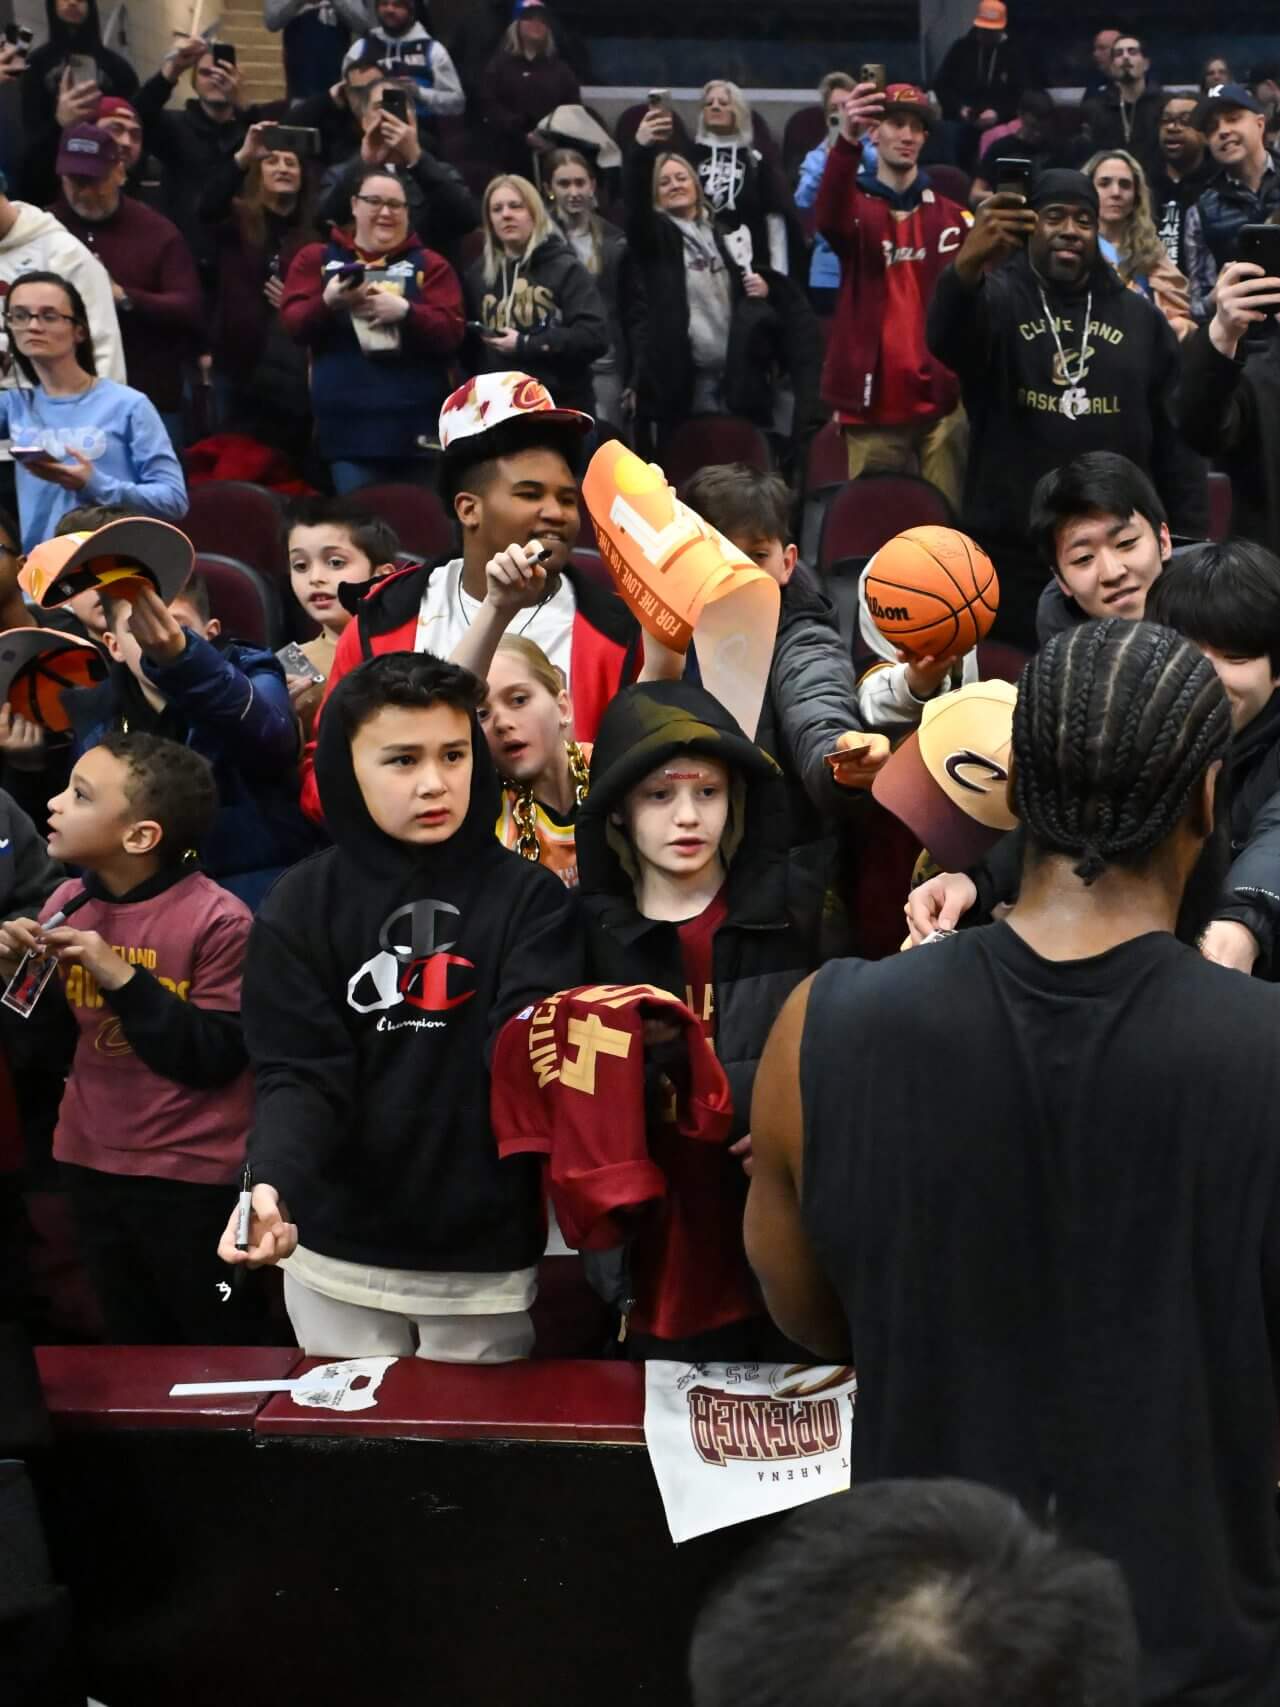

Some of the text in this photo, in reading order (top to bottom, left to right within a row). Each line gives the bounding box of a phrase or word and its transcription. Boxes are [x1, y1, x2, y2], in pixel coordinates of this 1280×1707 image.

[638, 590, 659, 617] THE
[656, 608, 682, 637] FOR
[376, 1016, 447, 1032] Champion
[687, 1388, 842, 1467] OPENER
[757, 1464, 822, 1482] ARENA
